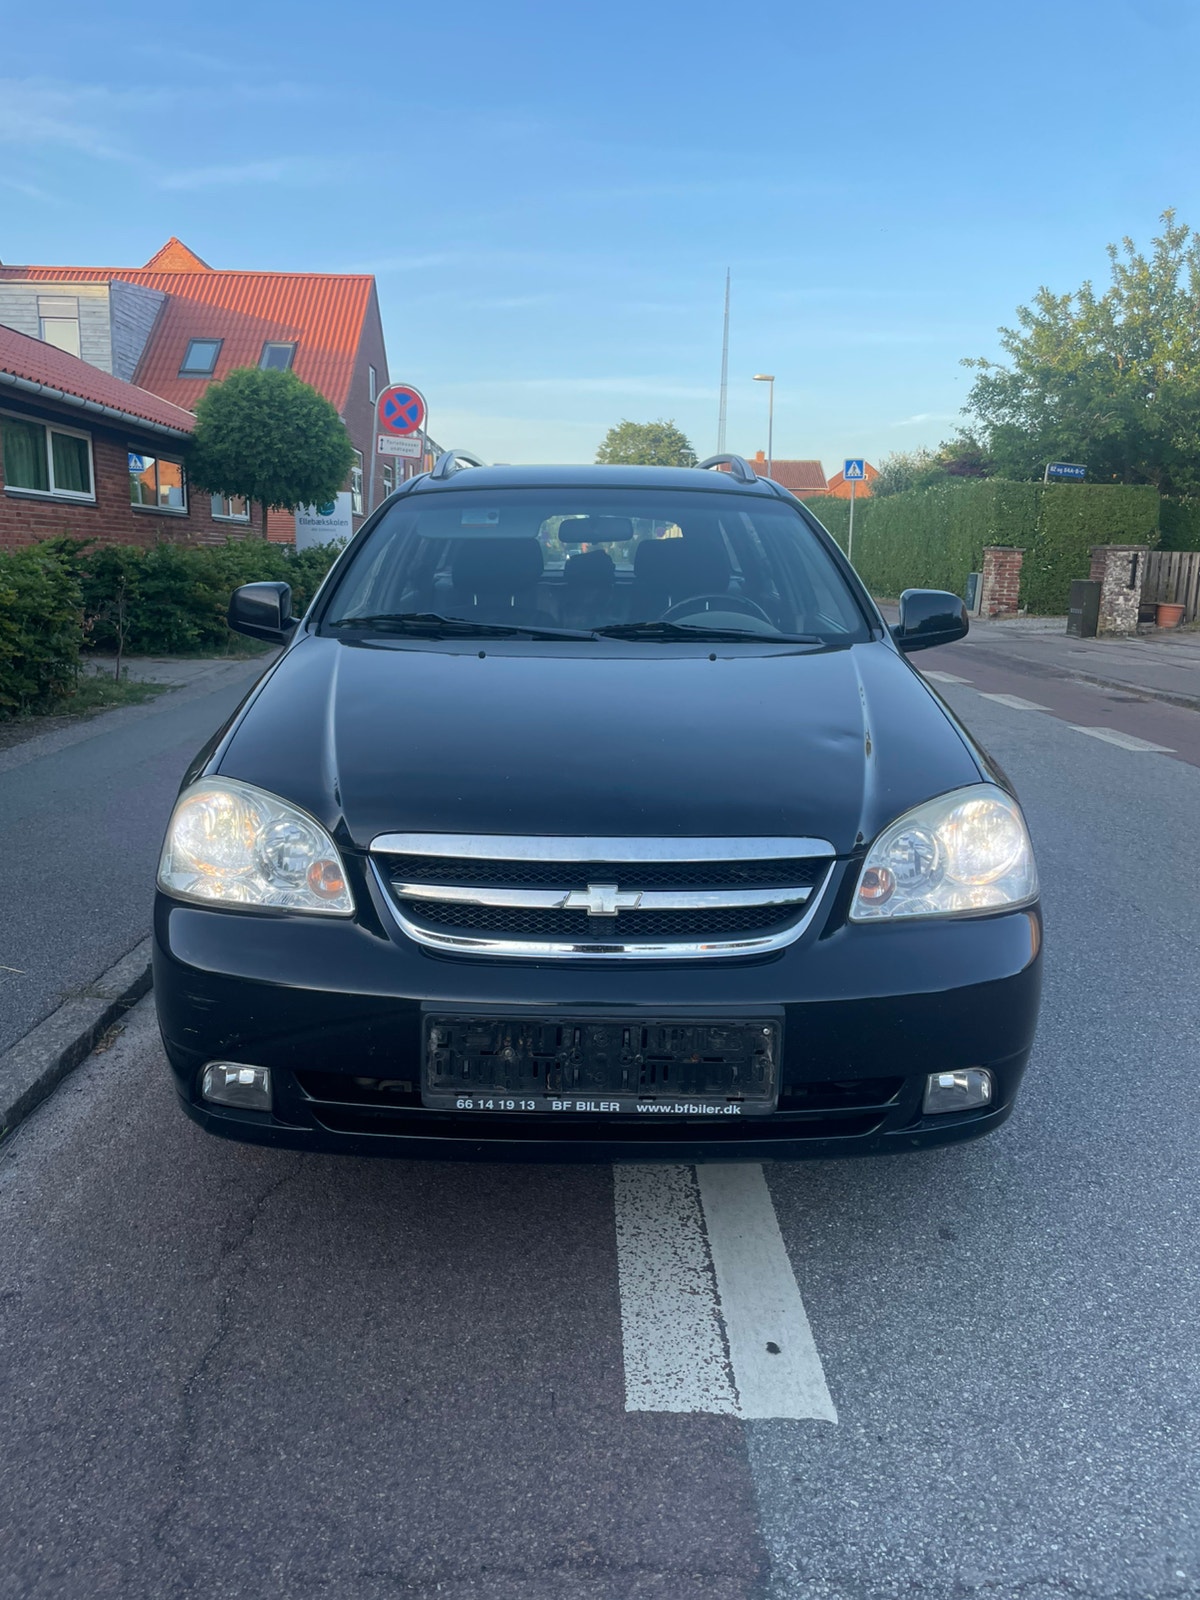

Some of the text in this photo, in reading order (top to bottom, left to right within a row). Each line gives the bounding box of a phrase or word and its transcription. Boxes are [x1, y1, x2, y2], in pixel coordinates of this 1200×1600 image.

[299, 517, 349, 526] Ellebækskolen
[456, 1099, 741, 1114] 66 14 19 13 BF BILER www.bfbiler.dk
